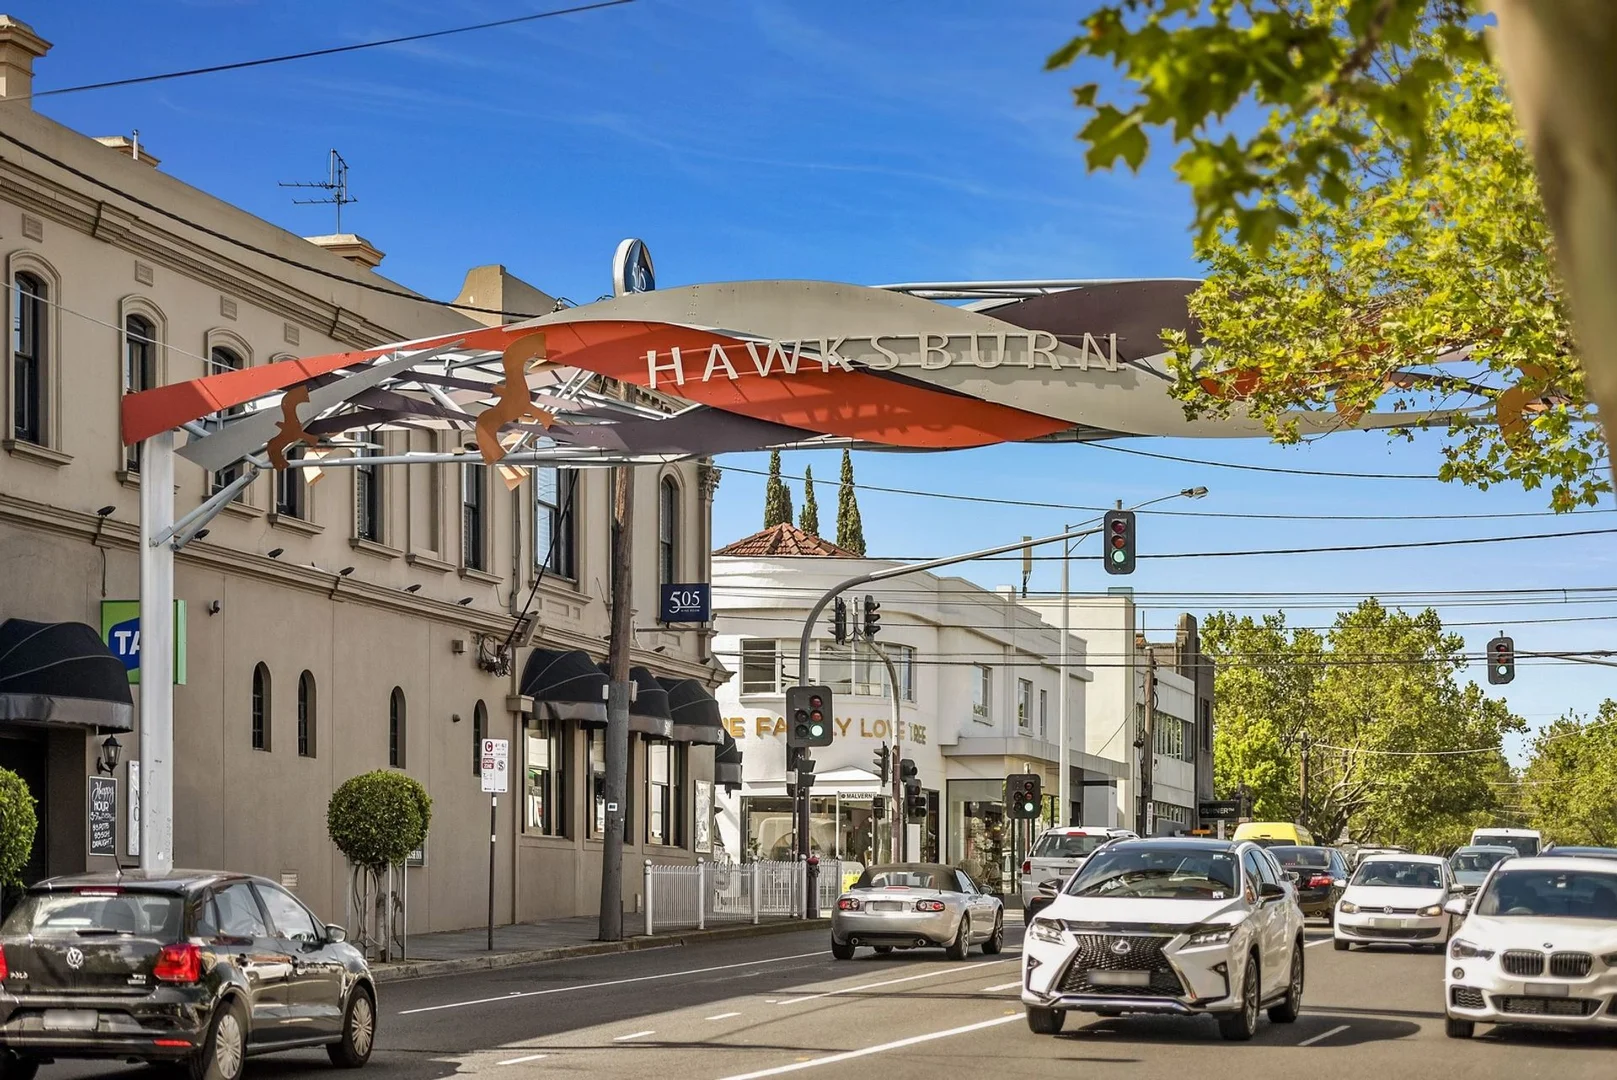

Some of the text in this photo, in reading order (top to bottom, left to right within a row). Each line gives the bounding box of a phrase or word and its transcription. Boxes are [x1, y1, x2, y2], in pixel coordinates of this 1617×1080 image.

[647, 331, 1118, 389] HAWKSBURN
[669, 590, 701, 613] 505
[114, 630, 140, 655] TA
[94, 801, 110, 811] HOUR
